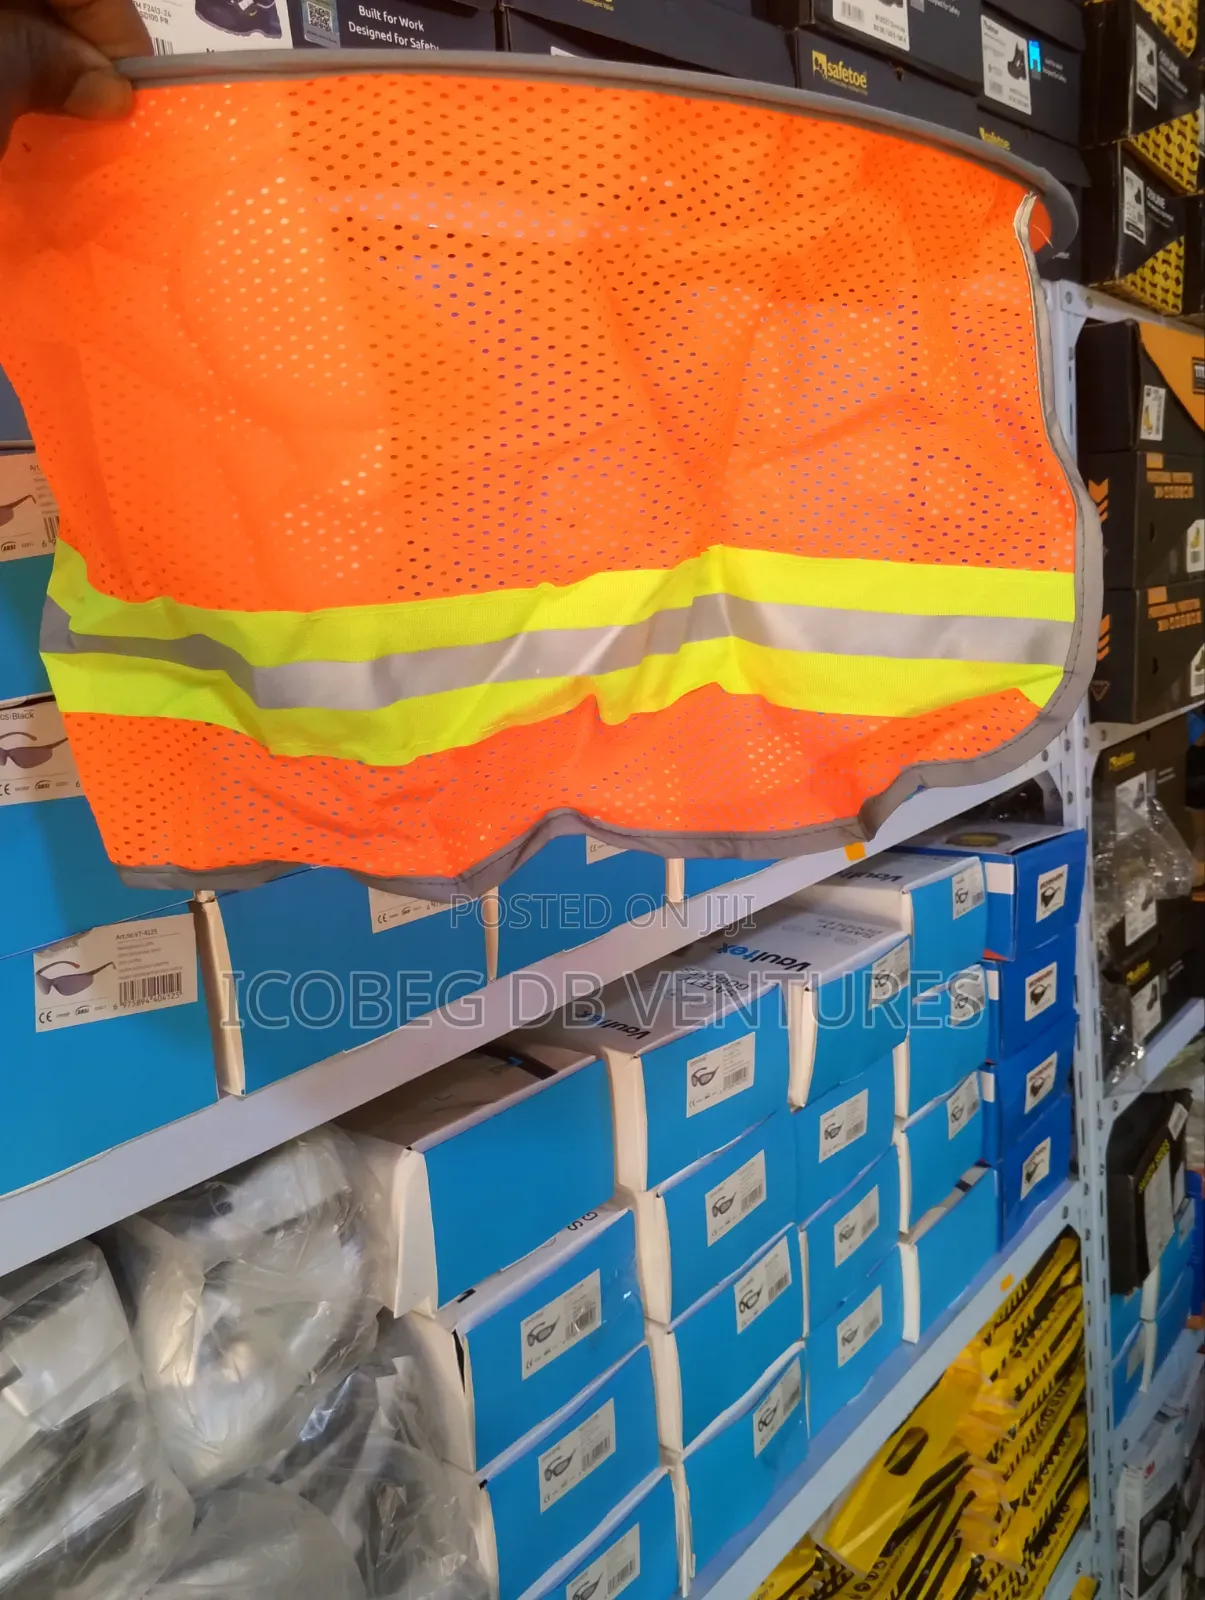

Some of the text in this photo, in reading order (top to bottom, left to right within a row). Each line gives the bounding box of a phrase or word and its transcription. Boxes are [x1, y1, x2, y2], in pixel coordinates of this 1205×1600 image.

[358, 5, 425, 32] Built for Work
[348, 21, 392, 43] Designed
[394, 33, 408, 46] for
[827, 61, 868, 89] safetoe
[716, 942, 812, 973] Vaultex
